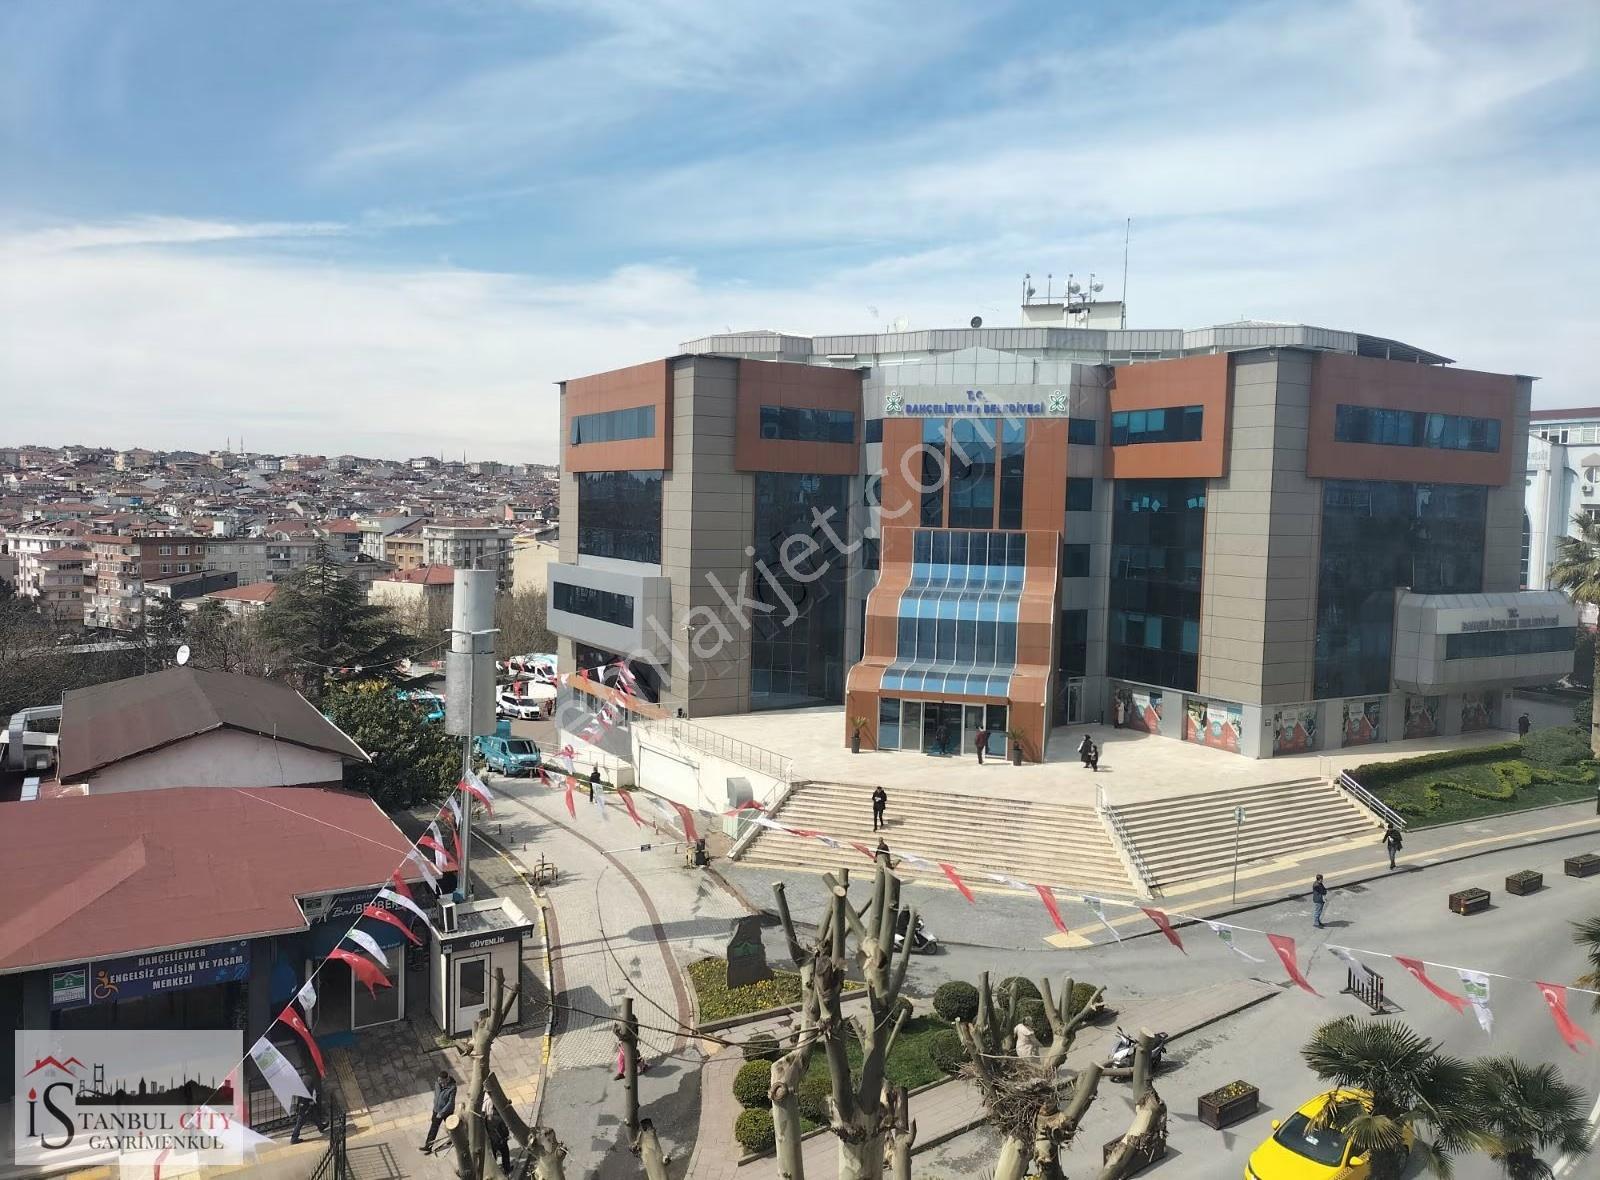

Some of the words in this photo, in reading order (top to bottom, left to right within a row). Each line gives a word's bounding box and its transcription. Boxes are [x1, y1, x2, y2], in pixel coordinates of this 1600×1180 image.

[469, 936, 505, 948] GÜVENLİK
[138, 948, 206, 967] BAHÇELİEVLER
[110, 968, 155, 984] ENGELSİZ
[157, 962, 196, 976] GELİŞİM
[199, 960, 210, 970] VE
[152, 974, 193, 990] MERKEZİ
